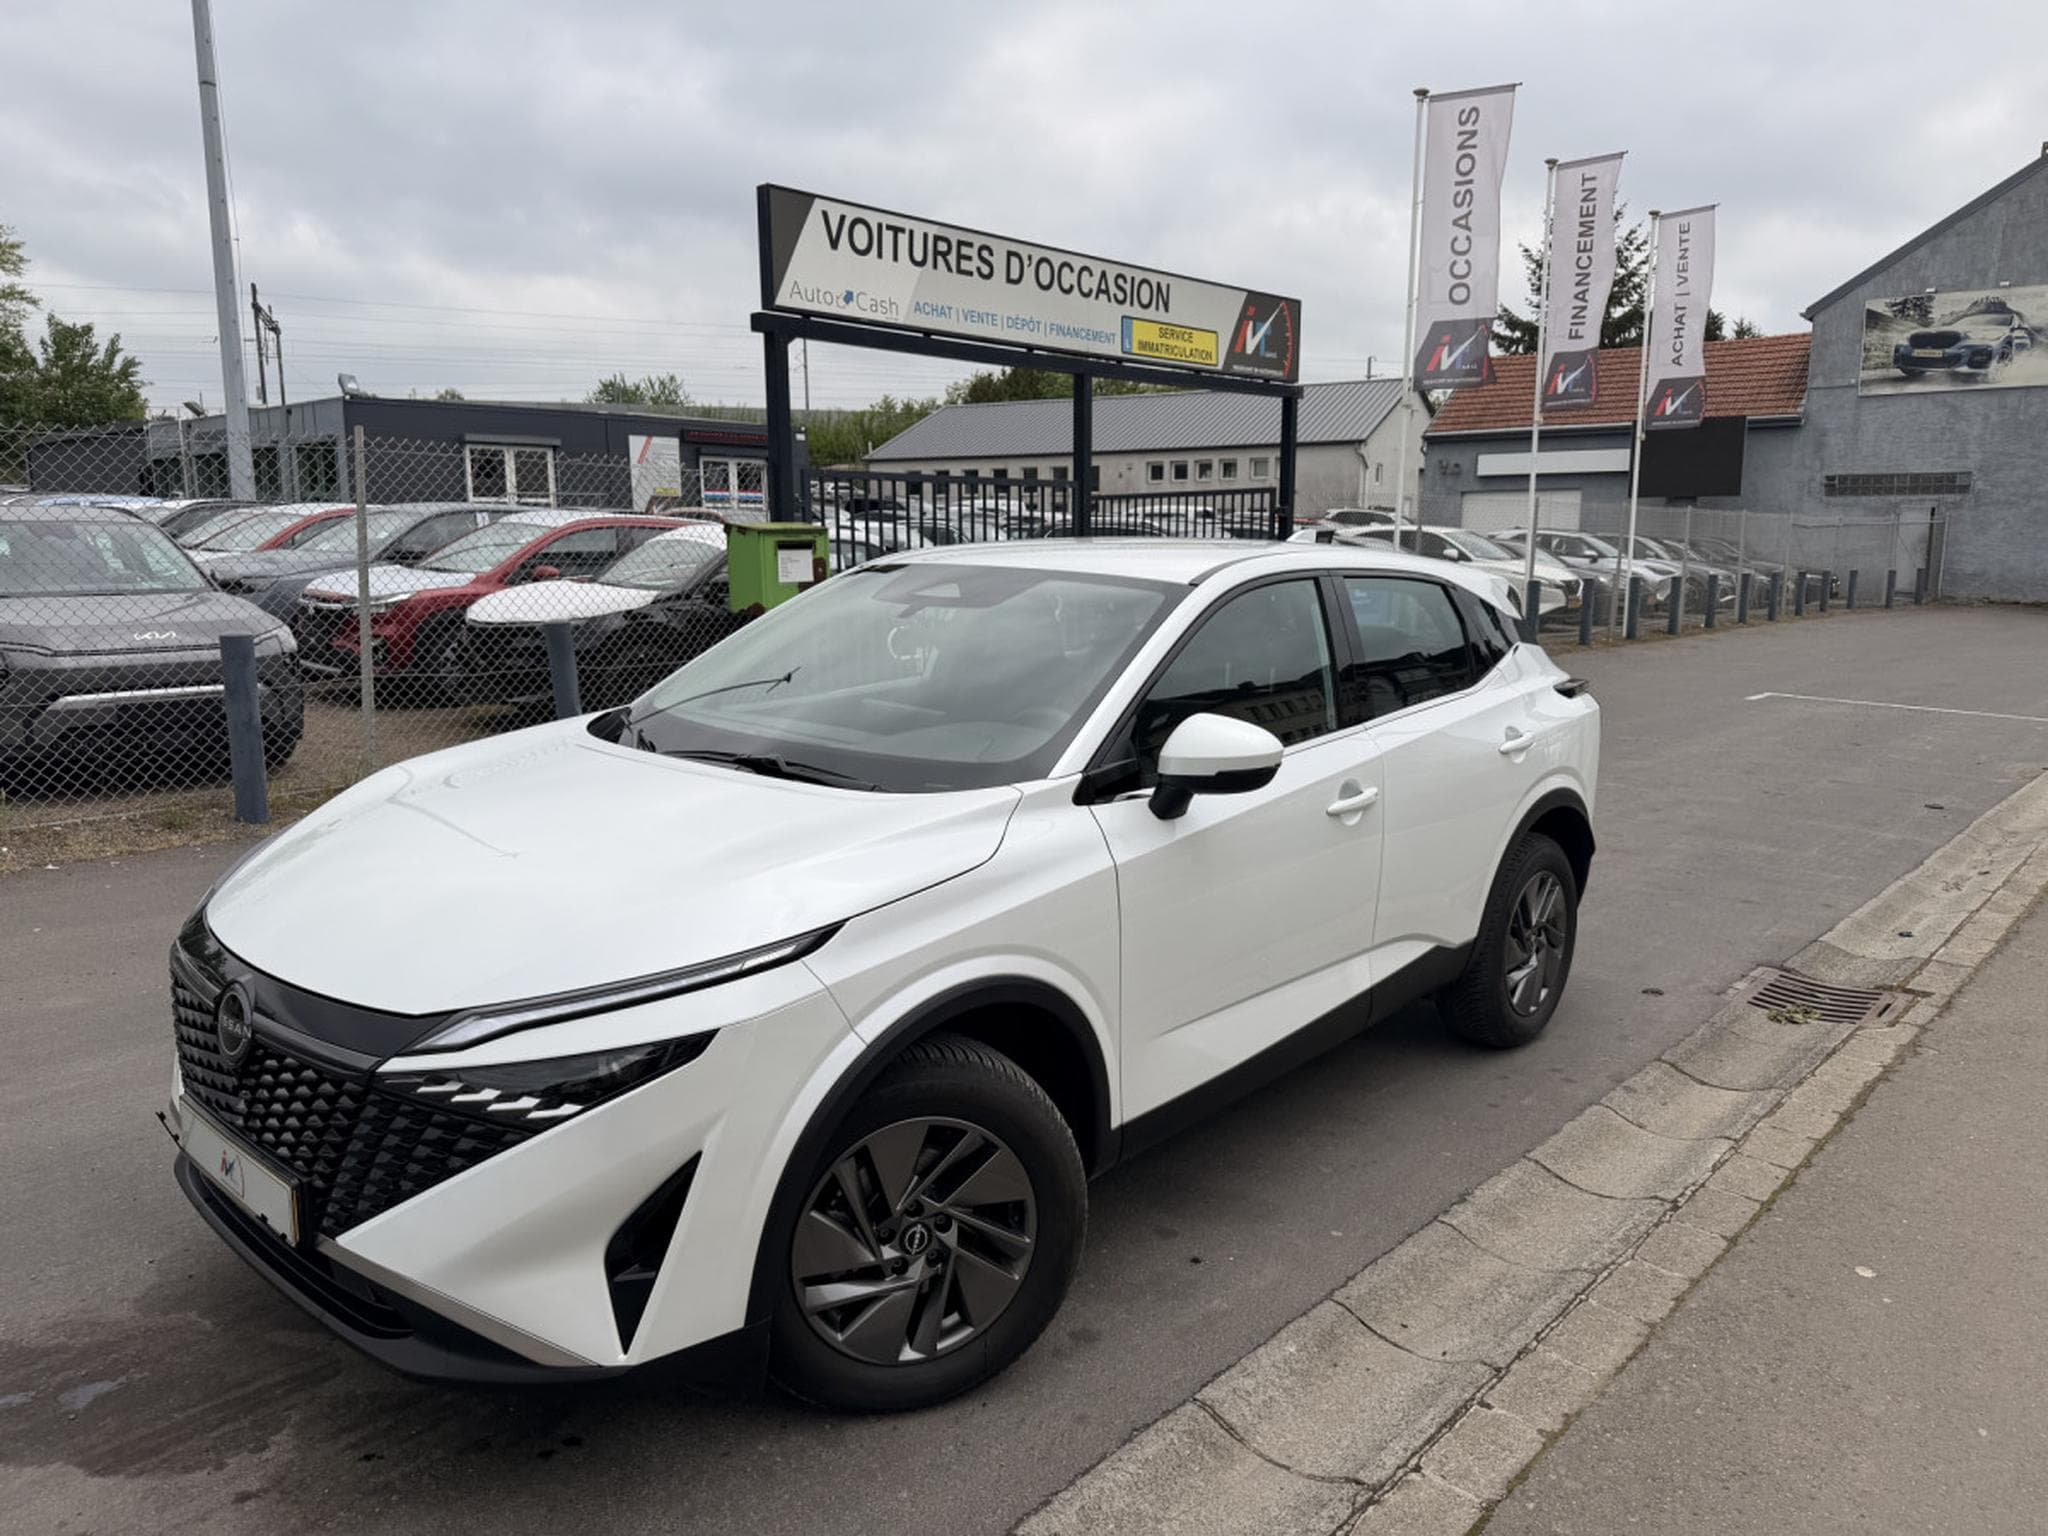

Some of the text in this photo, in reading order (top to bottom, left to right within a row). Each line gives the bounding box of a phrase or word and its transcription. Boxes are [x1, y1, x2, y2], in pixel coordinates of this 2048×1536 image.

[1449, 105, 1480, 306] OCCASIONS
[821, 209, 994, 280] VOITURES
[1568, 172, 1597, 340] FINANCEMENT
[1676, 221, 1691, 288] VENTE
[914, 301, 953, 320] ACHAT
[962, 309, 998, 327] VENTE
[1006, 316, 1041, 334] DÉPÔT
[1050, 324, 1117, 345] FINANCEMENT
[1138, 340, 1213, 361] IMMATRICULATION
[1158, 327, 1194, 344] SERVICE
[1672, 303, 1687, 367] ACHAT
